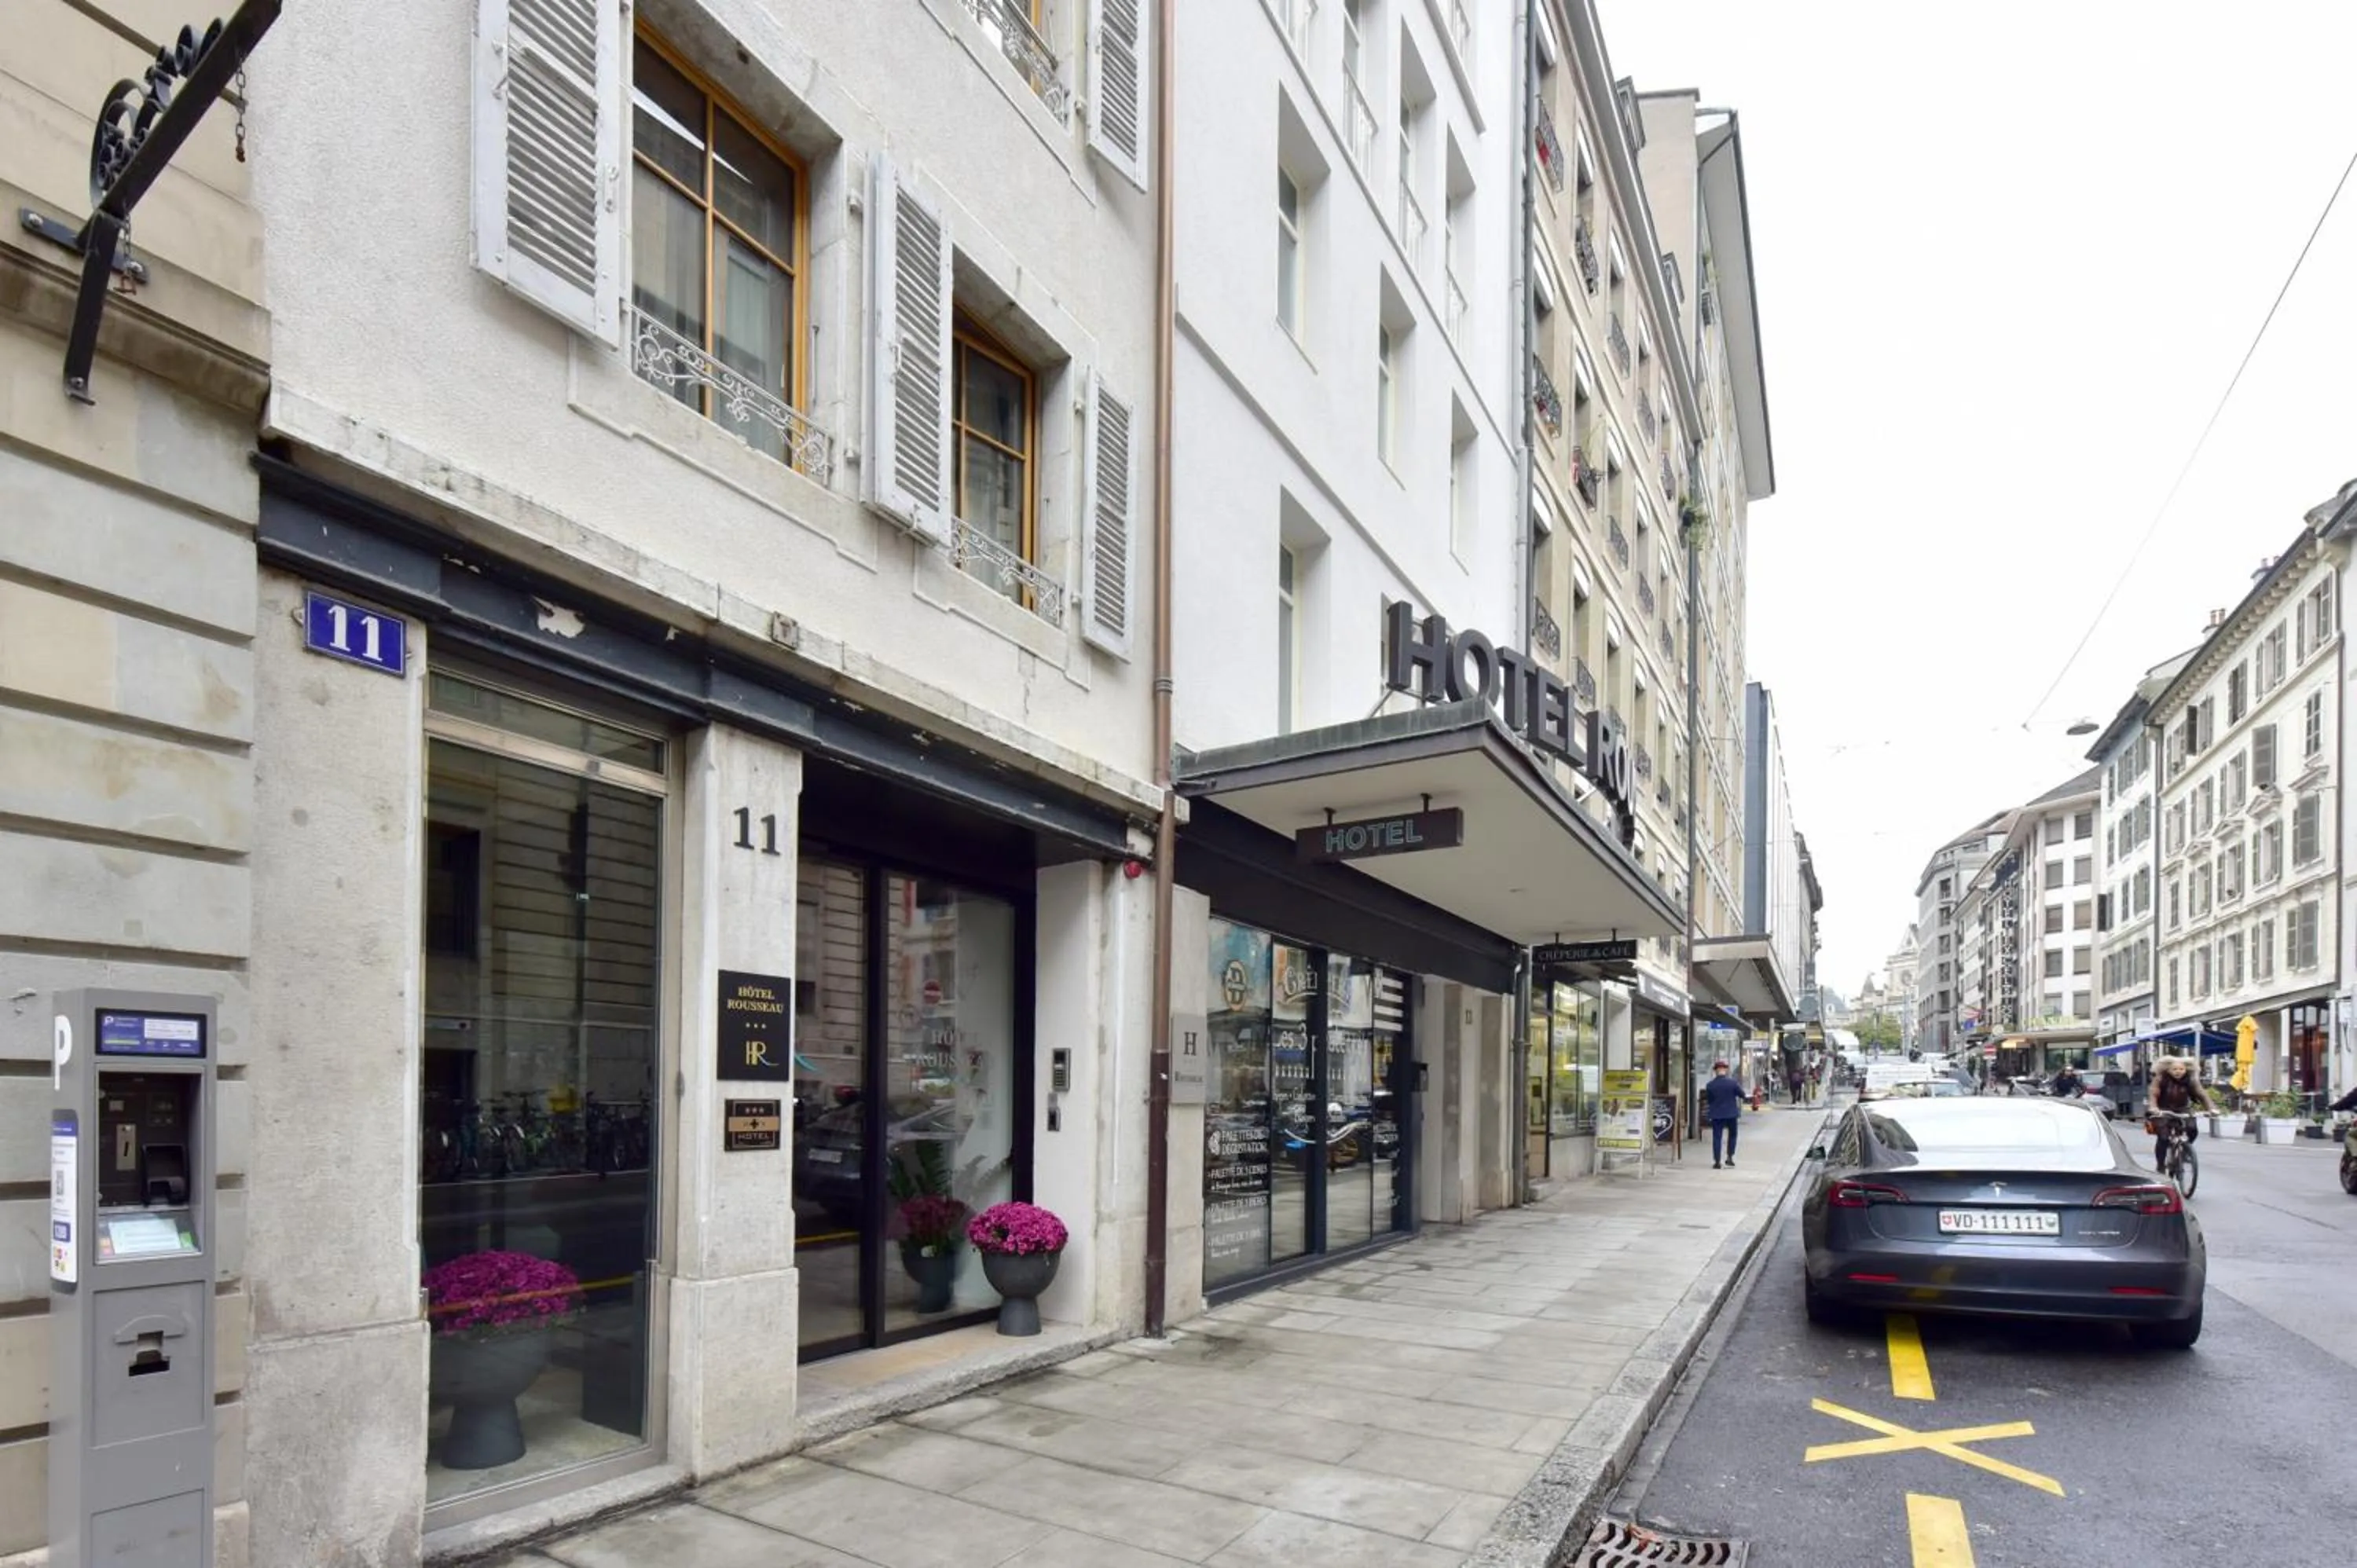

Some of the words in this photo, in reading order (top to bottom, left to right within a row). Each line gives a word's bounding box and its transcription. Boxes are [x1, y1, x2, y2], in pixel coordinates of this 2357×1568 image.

[328, 605, 383, 662] 11
[1387, 600, 1587, 768] HOTEL
[733, 806, 780, 856] 11
[1325, 819, 1424, 853] HOTEL
[728, 998, 784, 1013] ROUSSEAU
[738, 986, 775, 1000] HÔTEL
[54, 1014, 72, 1090] P
[1183, 1031, 1197, 1056] H
